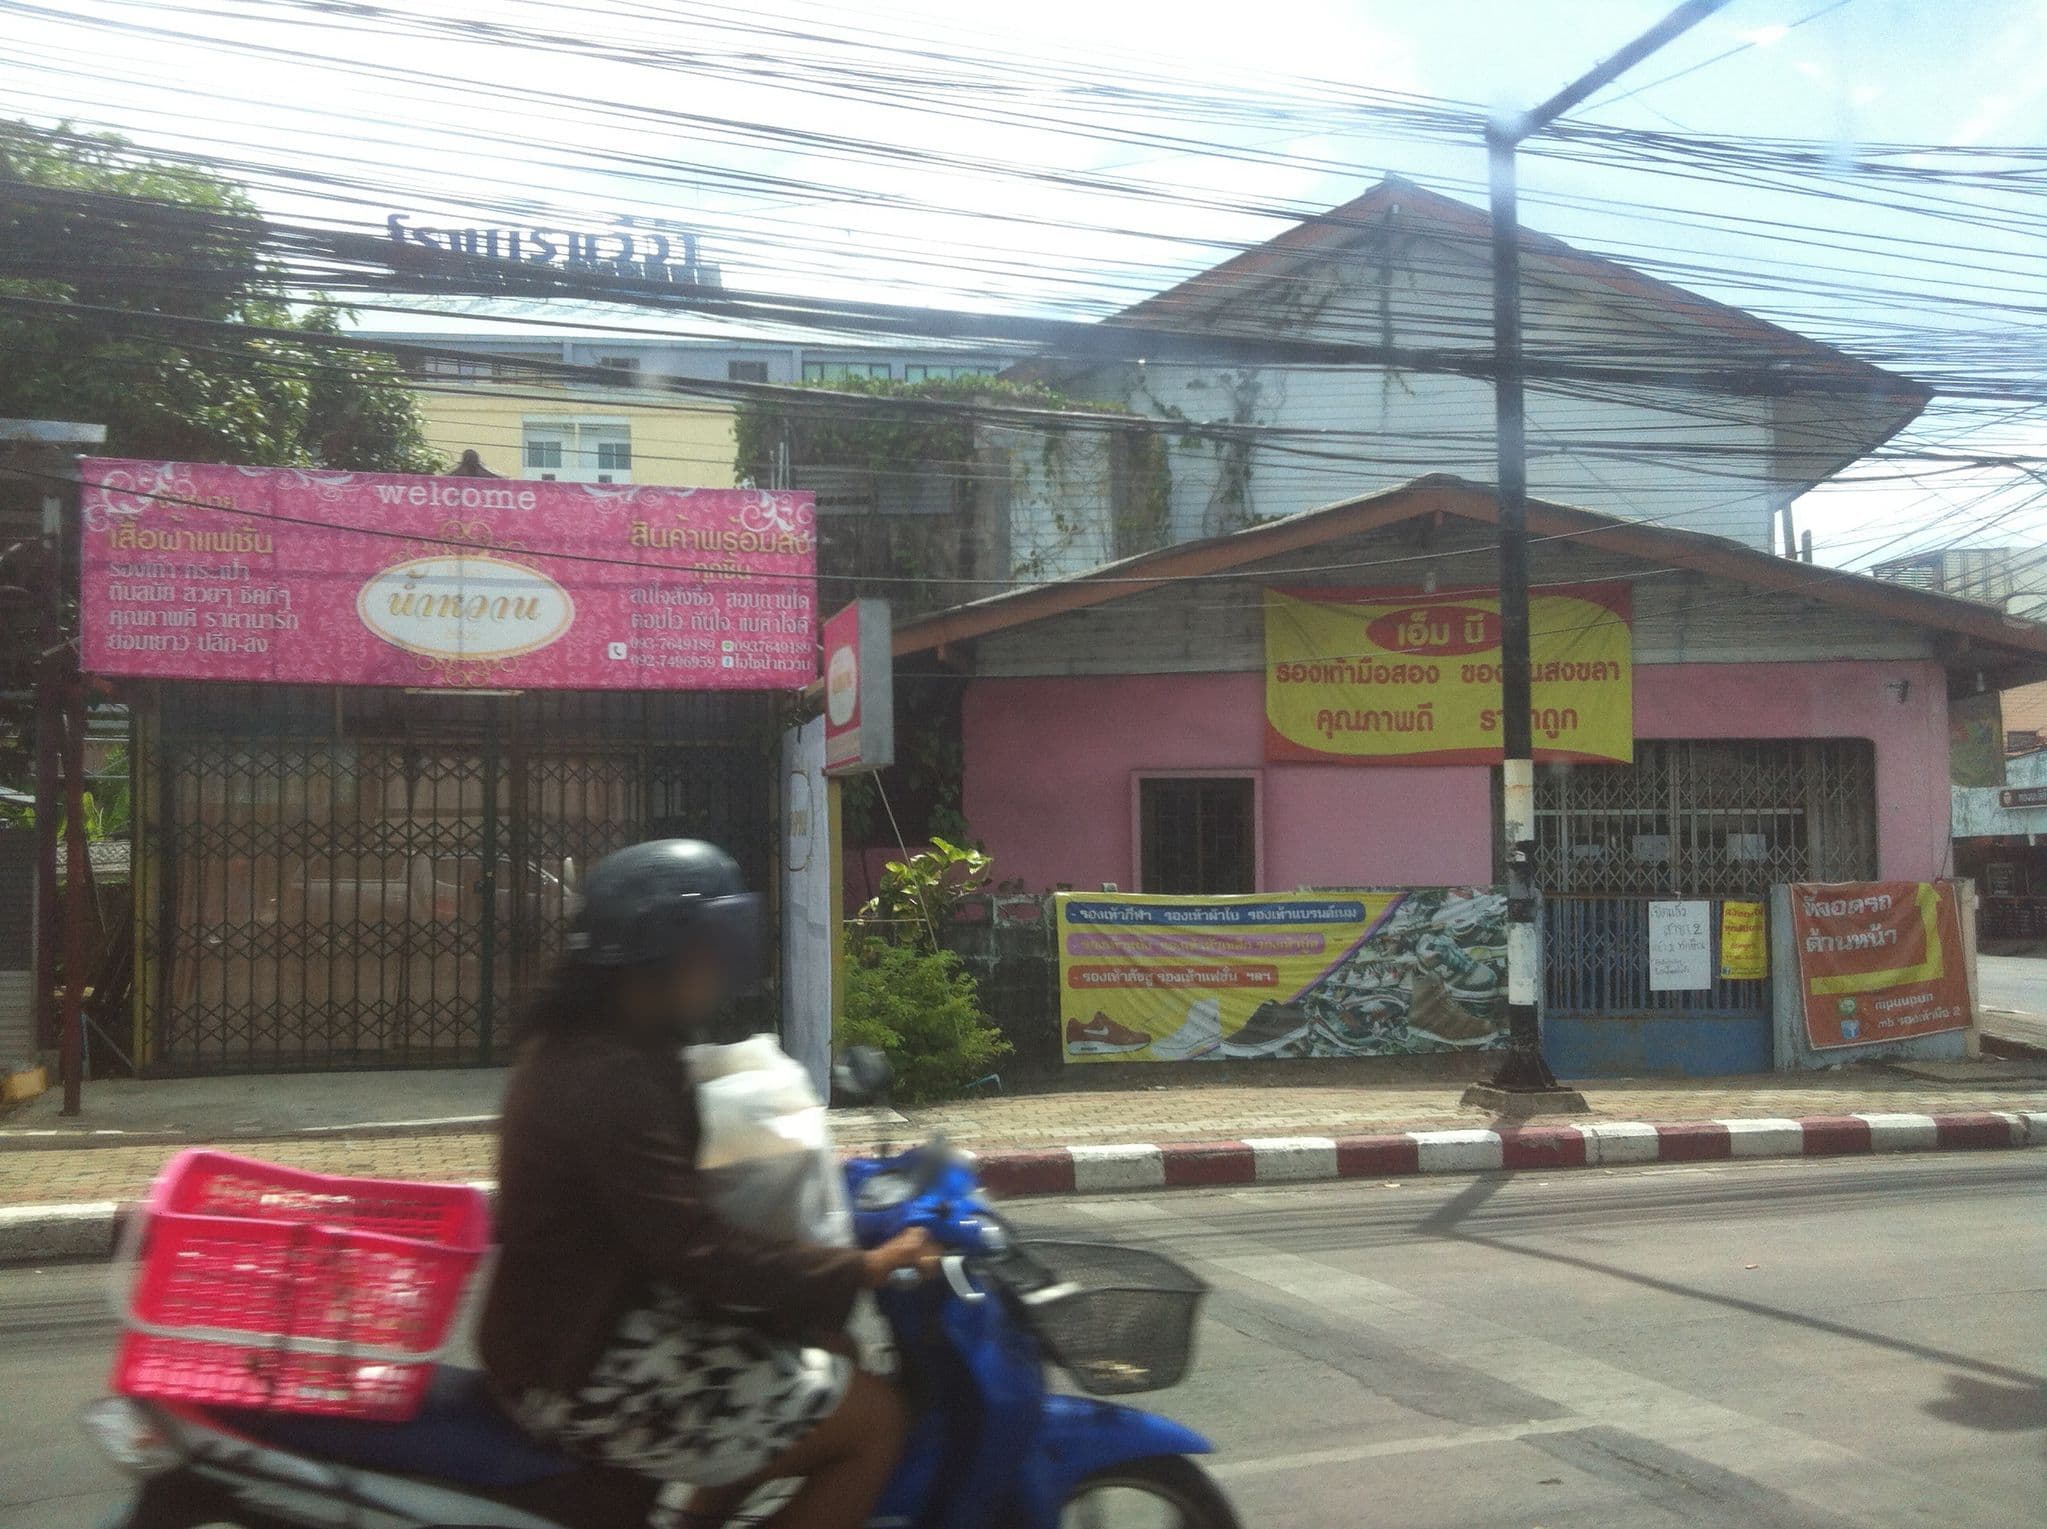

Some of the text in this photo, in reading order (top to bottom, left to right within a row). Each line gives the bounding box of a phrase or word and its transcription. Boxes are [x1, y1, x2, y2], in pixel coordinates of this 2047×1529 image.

[376, 482, 537, 510] welcome
[389, 569, 541, 621] น้ำหวาน
[1397, 610, 1450, 646] เอ็ม
[1275, 656, 1440, 686] รองเท้ามือสอง
[1316, 703, 1434, 739] คุณภาพดี
[1806, 923, 1897, 953] ด้านหน้า
